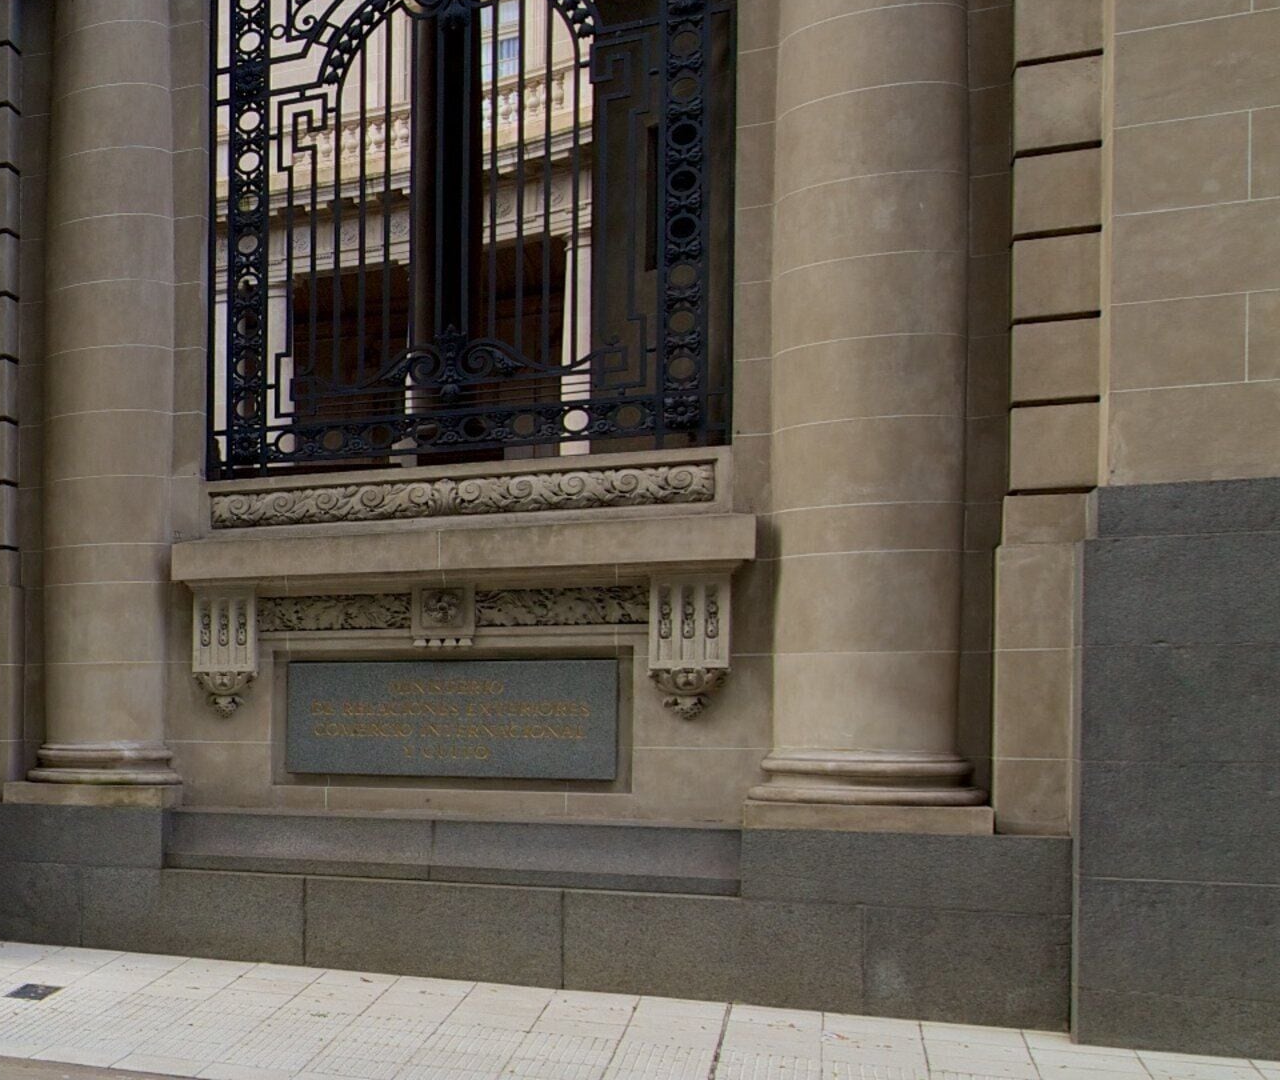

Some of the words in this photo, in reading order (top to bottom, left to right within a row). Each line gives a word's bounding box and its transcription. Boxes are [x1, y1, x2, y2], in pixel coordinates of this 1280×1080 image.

[311, 701, 335, 716] DE
[342, 701, 459, 716] RELACIONES
[466, 702, 591, 718] EXTERIORES
[313, 723, 413, 737] COMERCIO
[419, 723, 587, 739] INTERNACIONAL
[404, 745, 413, 758] Y
[423, 745, 490, 760] CULTO
